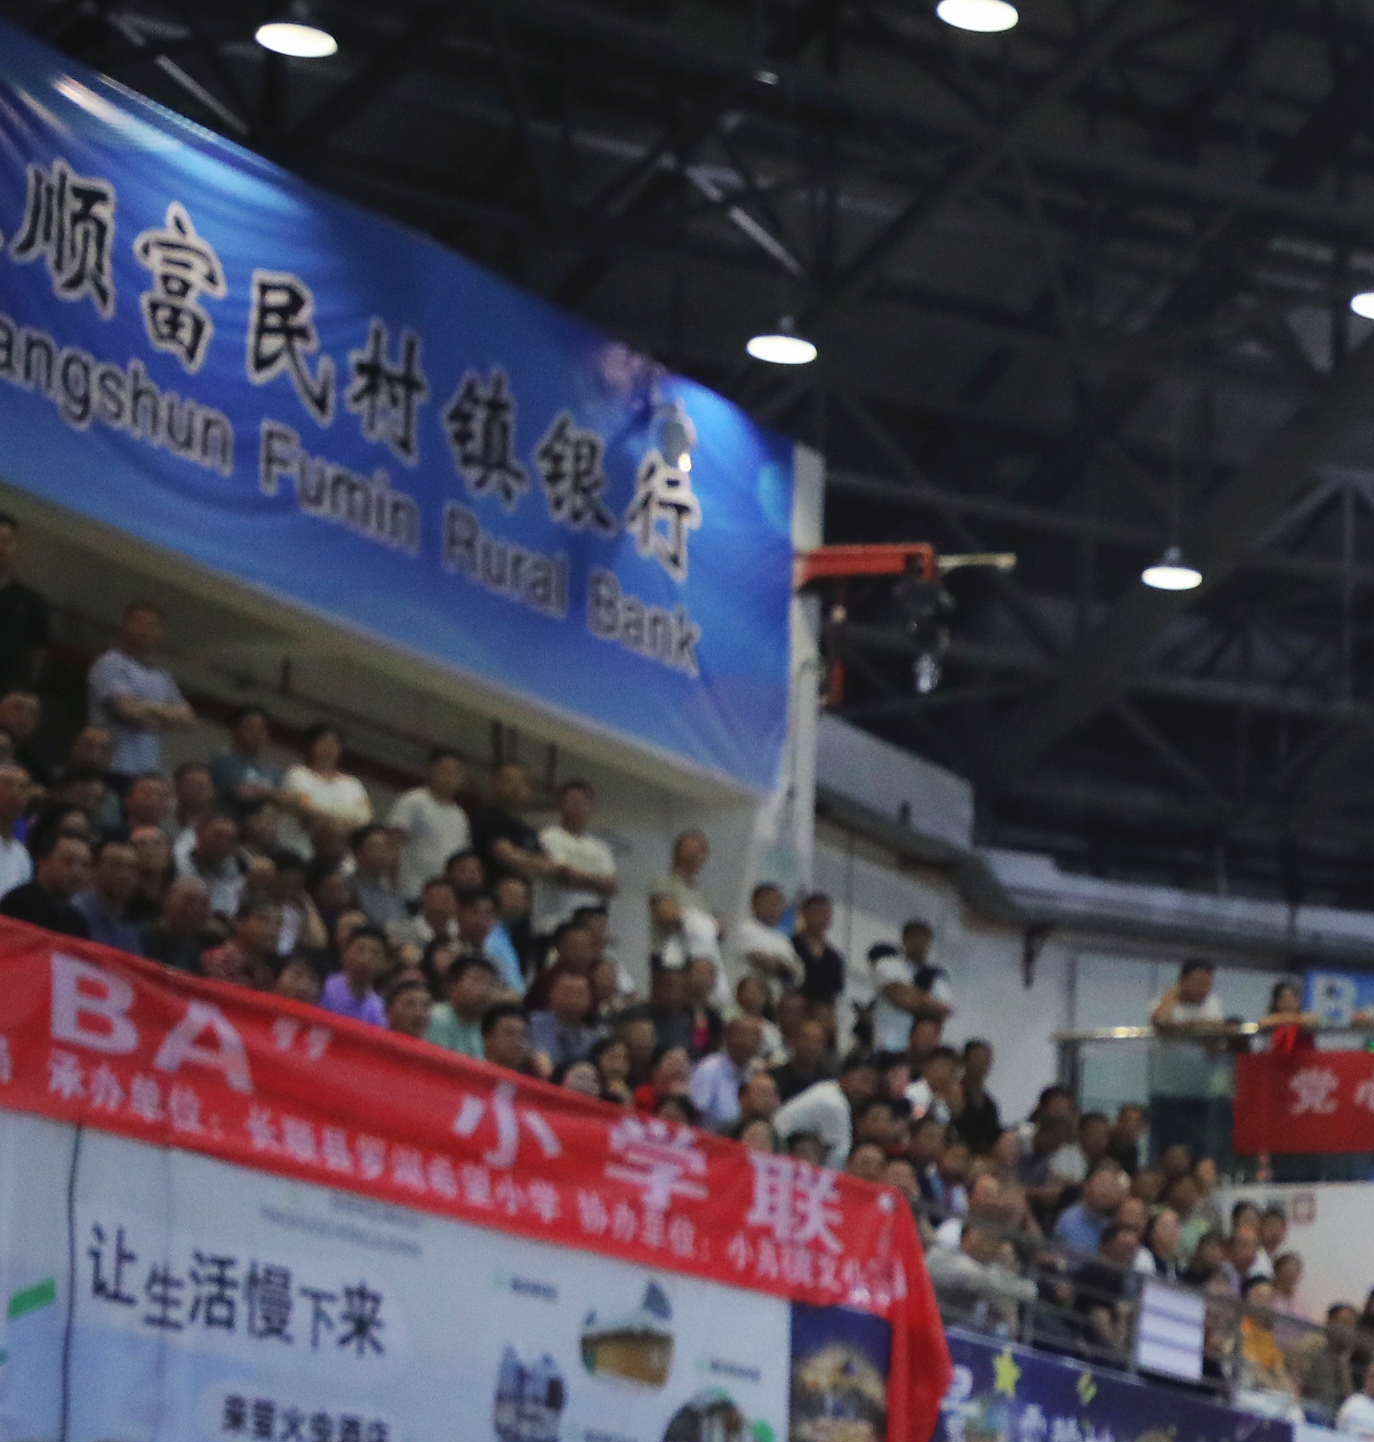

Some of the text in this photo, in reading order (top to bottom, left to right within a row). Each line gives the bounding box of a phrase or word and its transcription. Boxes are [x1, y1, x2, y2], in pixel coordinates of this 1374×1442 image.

[0, 158, 702, 582] 顺富民村镇银行
[259, 418, 421, 556] Fumin
[443, 500, 568, 621] Rural
[586, 570, 702, 676] Bank
[453, 1080, 845, 1255] 小学联
[87, 1224, 387, 1358] 让生活慢下来
